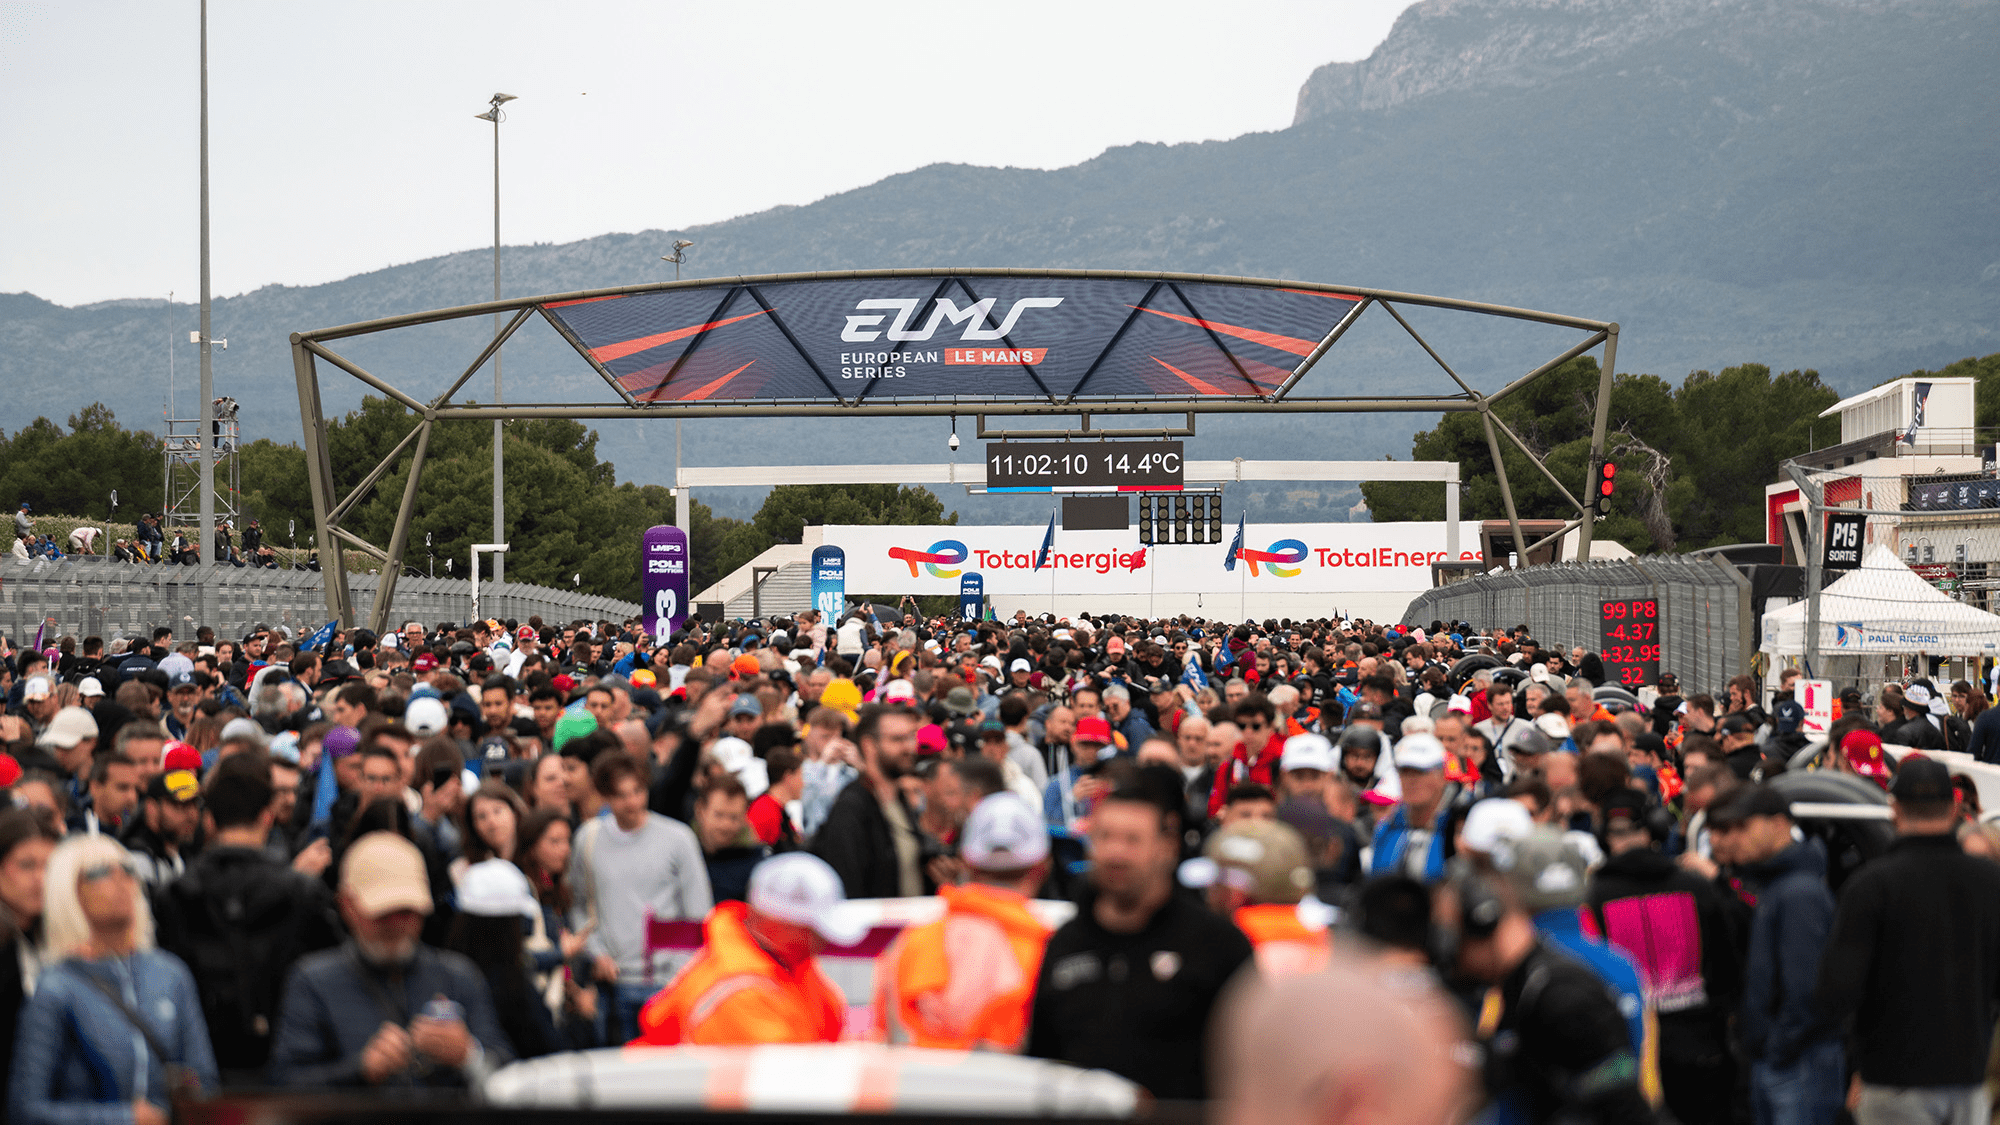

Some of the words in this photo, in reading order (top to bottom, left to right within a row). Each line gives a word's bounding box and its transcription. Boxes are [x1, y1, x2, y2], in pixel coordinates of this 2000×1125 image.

[841, 351, 938, 364] EUROPEAN
[954, 350, 976, 363] LE
[982, 350, 1034, 363] MANS
[841, 366, 906, 379] SERIES
[991, 454, 1088, 475] 11:02:10
[1832, 522, 1858, 547] P15
[649, 560, 683, 569] POLE
[1828, 550, 1857, 561] SORTIE
[1603, 602, 1627, 620] 99
[1632, 601, 1656, 618] P8
[1606, 623, 1654, 641] -4.37
[1868, 635, 1894, 643] PAUL
[1900, 635, 1938, 644] RICARD
[1601, 644, 1660, 663] +32.99
[1621, 666, 1644, 684] 32
